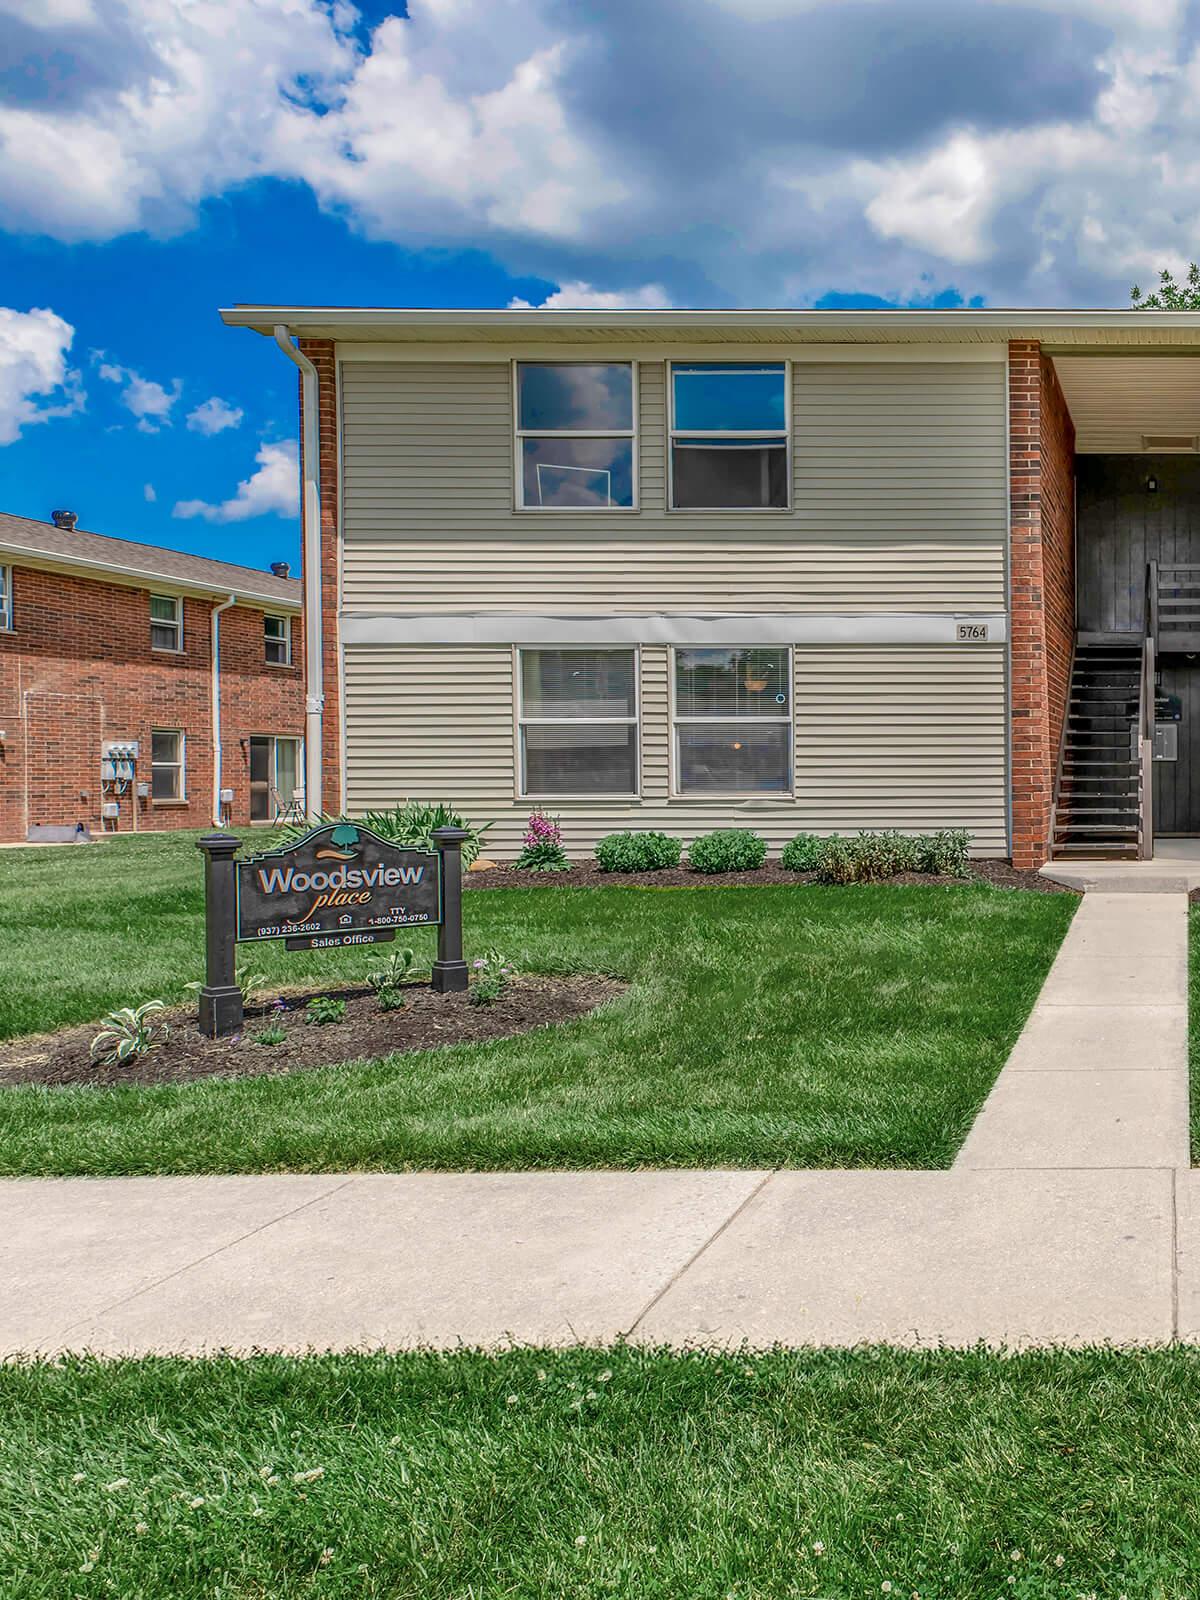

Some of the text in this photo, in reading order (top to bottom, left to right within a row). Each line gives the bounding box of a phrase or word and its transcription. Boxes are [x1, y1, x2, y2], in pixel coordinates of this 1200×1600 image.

[959, 626, 986, 639] 5764
[258, 862, 425, 895] Woodsview
[286, 886, 373, 925] place
[389, 906, 406, 915] TTY
[368, 913, 429, 925] 1-800-750-0750
[257, 922, 321, 937] (937) 236-2602
[310, 933, 375, 948] Sales Office
